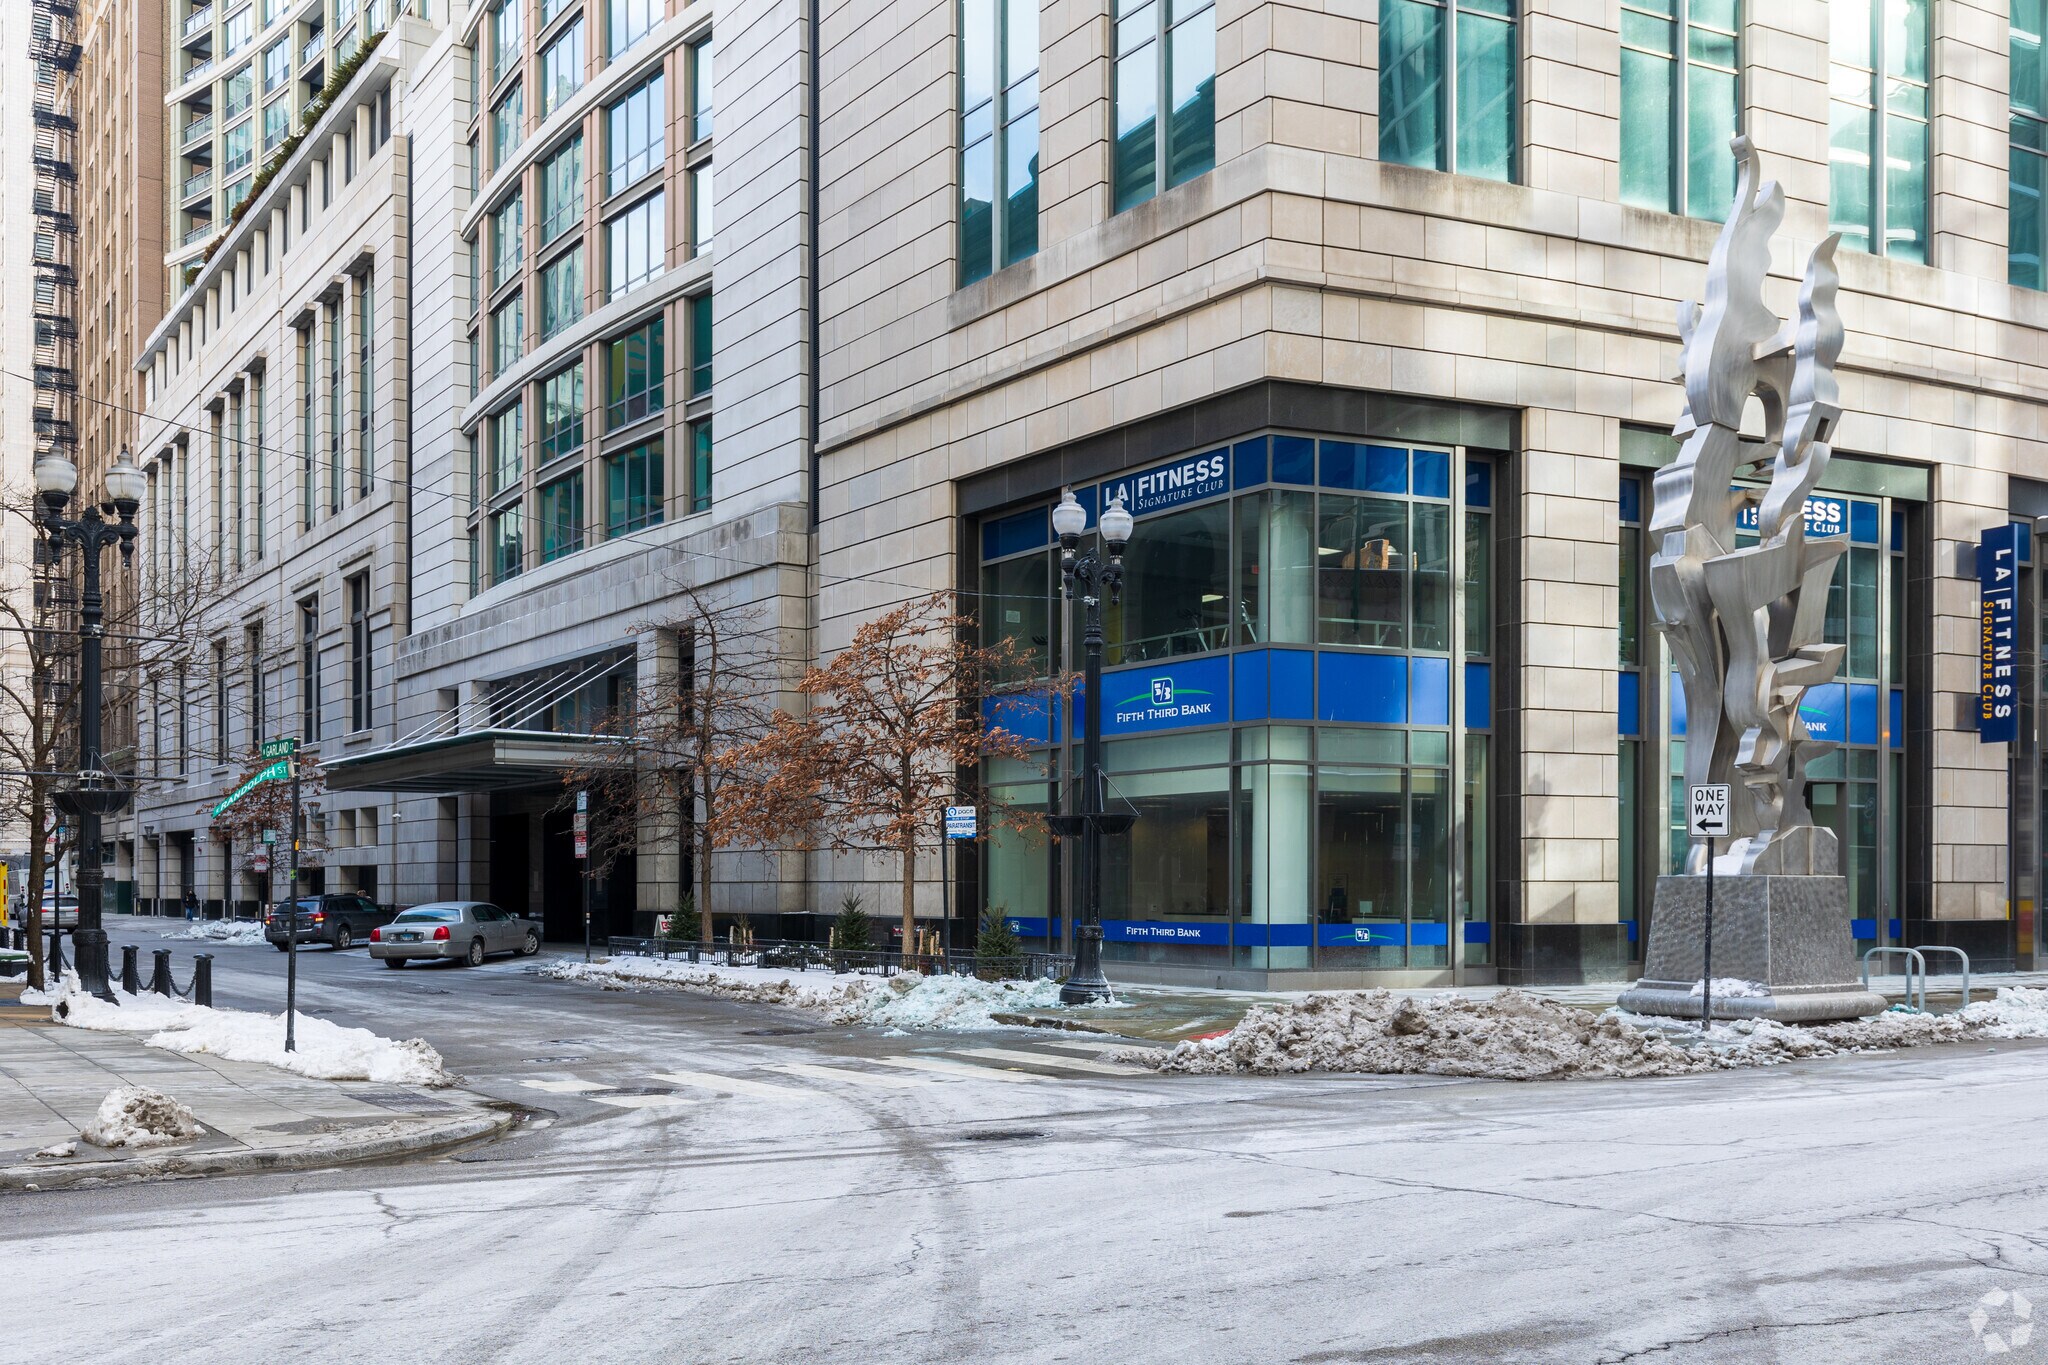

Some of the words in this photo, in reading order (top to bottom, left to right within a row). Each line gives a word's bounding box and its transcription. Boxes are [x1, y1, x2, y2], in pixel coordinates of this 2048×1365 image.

[1105, 482, 1129, 507] LA
[1138, 455, 1224, 497] FITNESS
[1138, 488, 1193, 511] SIGNATURE
[1196, 479, 1225, 495] CLUB
[1813, 521, 1840, 534] CLUB
[1995, 548, 2012, 582] LA
[1983, 601, 1994, 679] SIGNATURE
[1995, 597, 2012, 718] FITNESS
[1116, 711, 1144, 723] FIFTH
[1147, 707, 1179, 720] THIRD
[1181, 703, 1211, 716] BANK
[1982, 684, 1994, 720] CLUB
[1802, 720, 1827, 732] ANK
[266, 741, 289, 758] GARLAND
[220, 766, 276, 812] RANDOLPH
[277, 766, 287, 774] ST
[1695, 789, 1725, 801] ONE
[1694, 803, 1725, 815] WAY
[1126, 926, 1149, 936] FIFTH
[1150, 927, 1176, 937] THIRD
[1177, 928, 1201, 938] BANK
